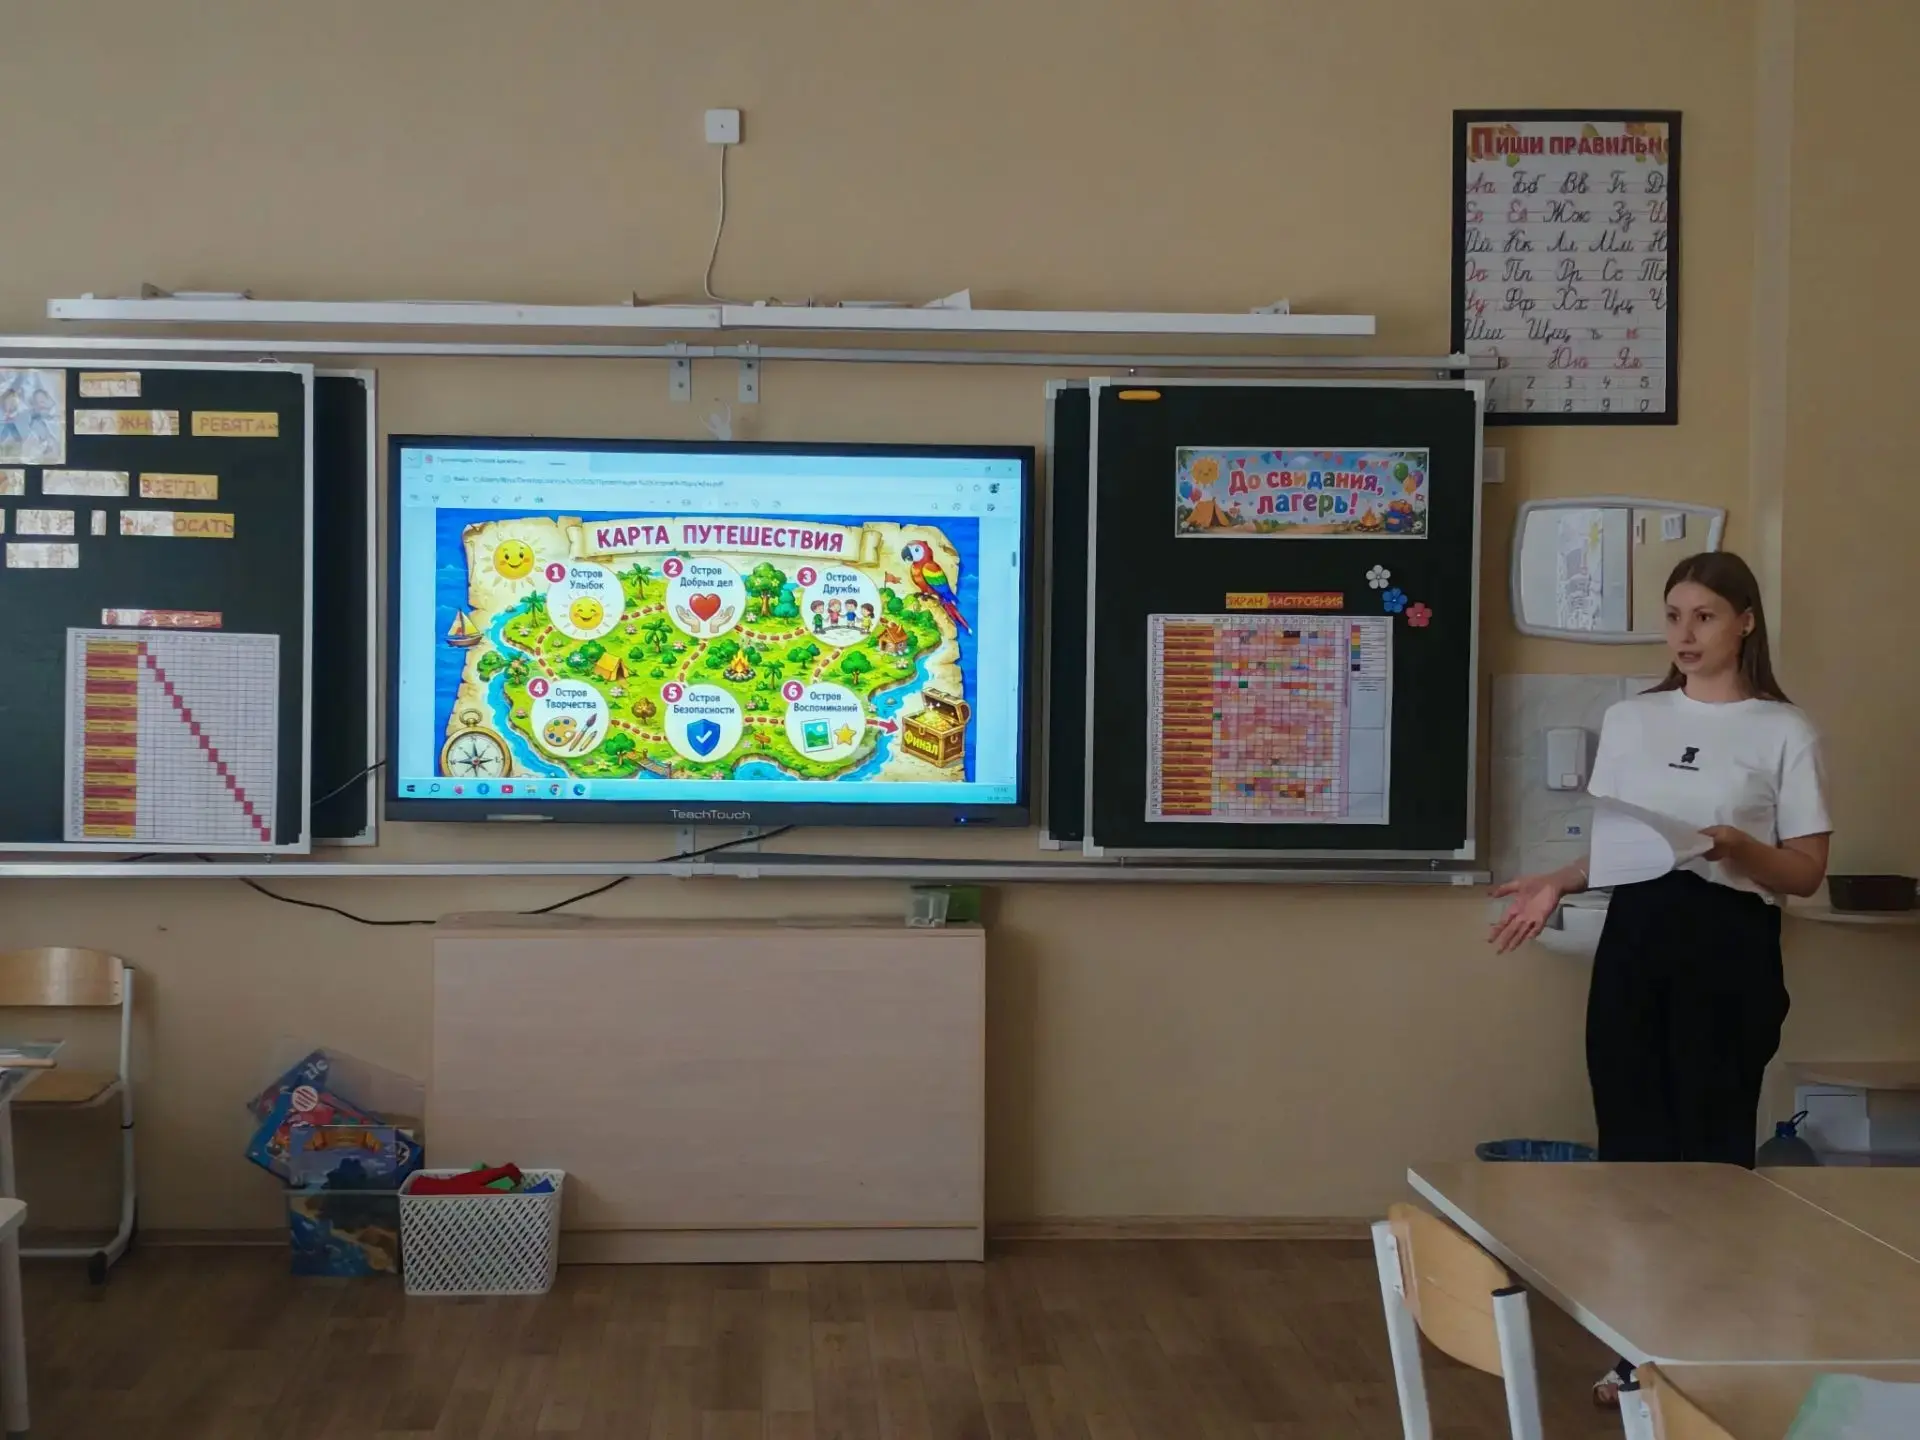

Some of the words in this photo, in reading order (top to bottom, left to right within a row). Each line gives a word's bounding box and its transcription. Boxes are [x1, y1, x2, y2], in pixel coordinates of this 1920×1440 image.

[1228, 470, 1261, 495] До
[1266, 470, 1384, 496] свидания,
[1256, 492, 1358, 517] лагерь!
[597, 525, 670, 548] КАРТА
[683, 524, 843, 553] ПУТЕШЕСТВИЯ
[551, 567, 561, 580] 1
[668, 562, 678, 574] 2
[691, 565, 722, 576] Остров
[571, 568, 603, 581] Остров
[803, 571, 812, 583] 3
[826, 572, 858, 584] Остров
[570, 580, 604, 590] Улыбок
[680, 577, 714, 588] Добрых
[717, 579, 733, 588] дел
[823, 584, 860, 595] Дружбы
[534, 682, 544, 694] 4
[555, 687, 588, 699] Остров
[668, 687, 678, 699] 5
[787, 685, 798, 698] 6
[689, 692, 720, 704] Остров
[810, 691, 842, 703] Остров
[546, 699, 597, 710] Творчества
[673, 704, 735, 714] Безопасности
[794, 703, 858, 714] Воспоминаний
[903, 732, 939, 756] Финал
[669, 809, 752, 820] TeachTouch
